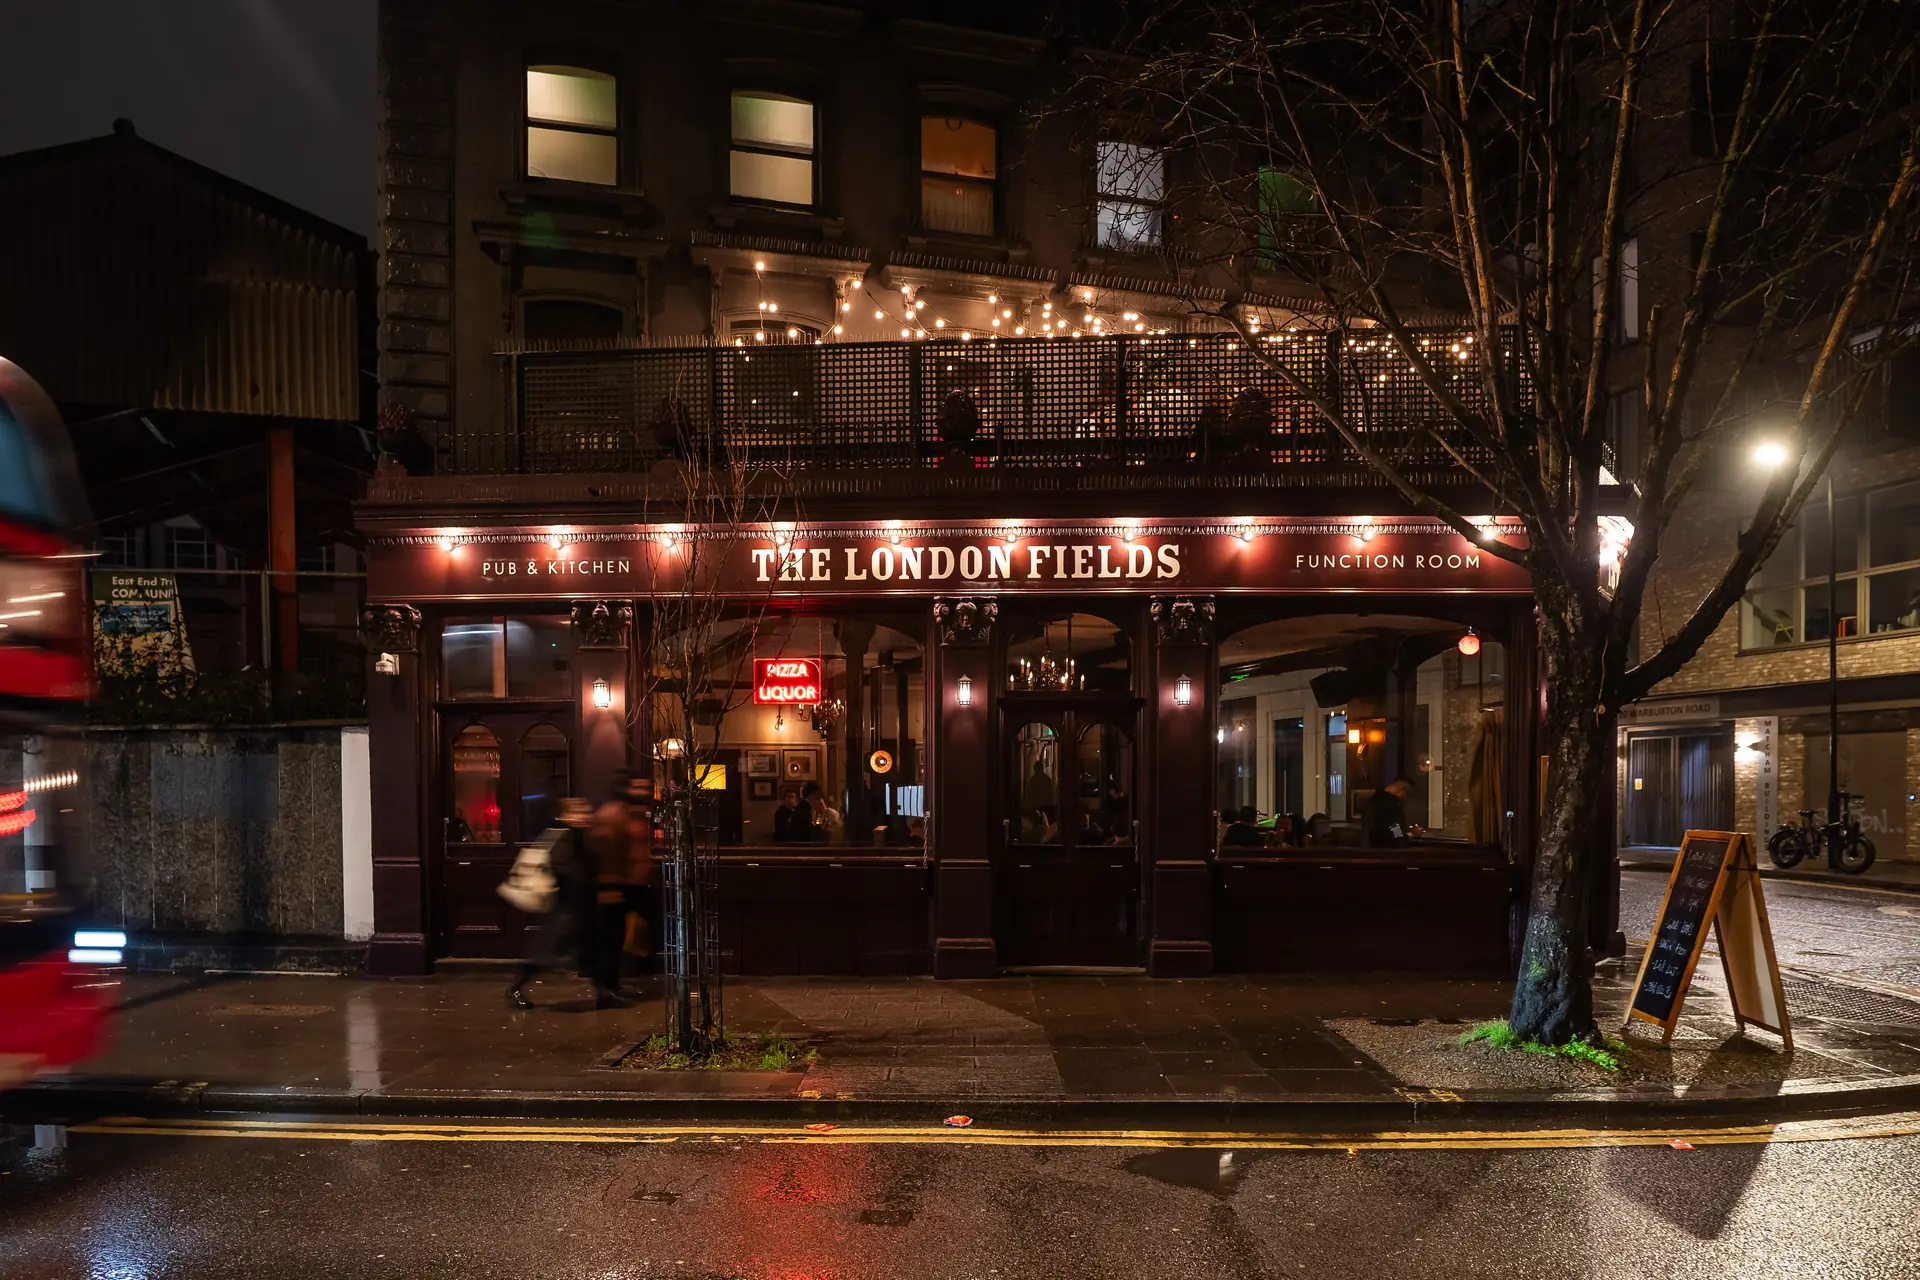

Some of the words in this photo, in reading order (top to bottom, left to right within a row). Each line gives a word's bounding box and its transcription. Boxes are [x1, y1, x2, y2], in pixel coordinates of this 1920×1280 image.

[483, 562, 517, 576] PUB
[527, 561, 538, 575] &
[548, 560, 630, 575] KITCHEN
[752, 548, 831, 582] THE
[844, 546, 1011, 581] LONDON
[1027, 544, 1181, 579] FIELDS
[1296, 554, 1404, 569] FUNCTION
[1416, 554, 1480, 569] ROOM
[111, 576, 135, 586] East
[137, 577, 158, 587] End
[767, 663, 808, 677] PIZZA
[759, 685, 816, 701] LIQUOR
[1629, 705, 1684, 719] WARBURTON
[1685, 702, 1712, 715] ROAD
[1763, 720, 1772, 774] MATCHAM
